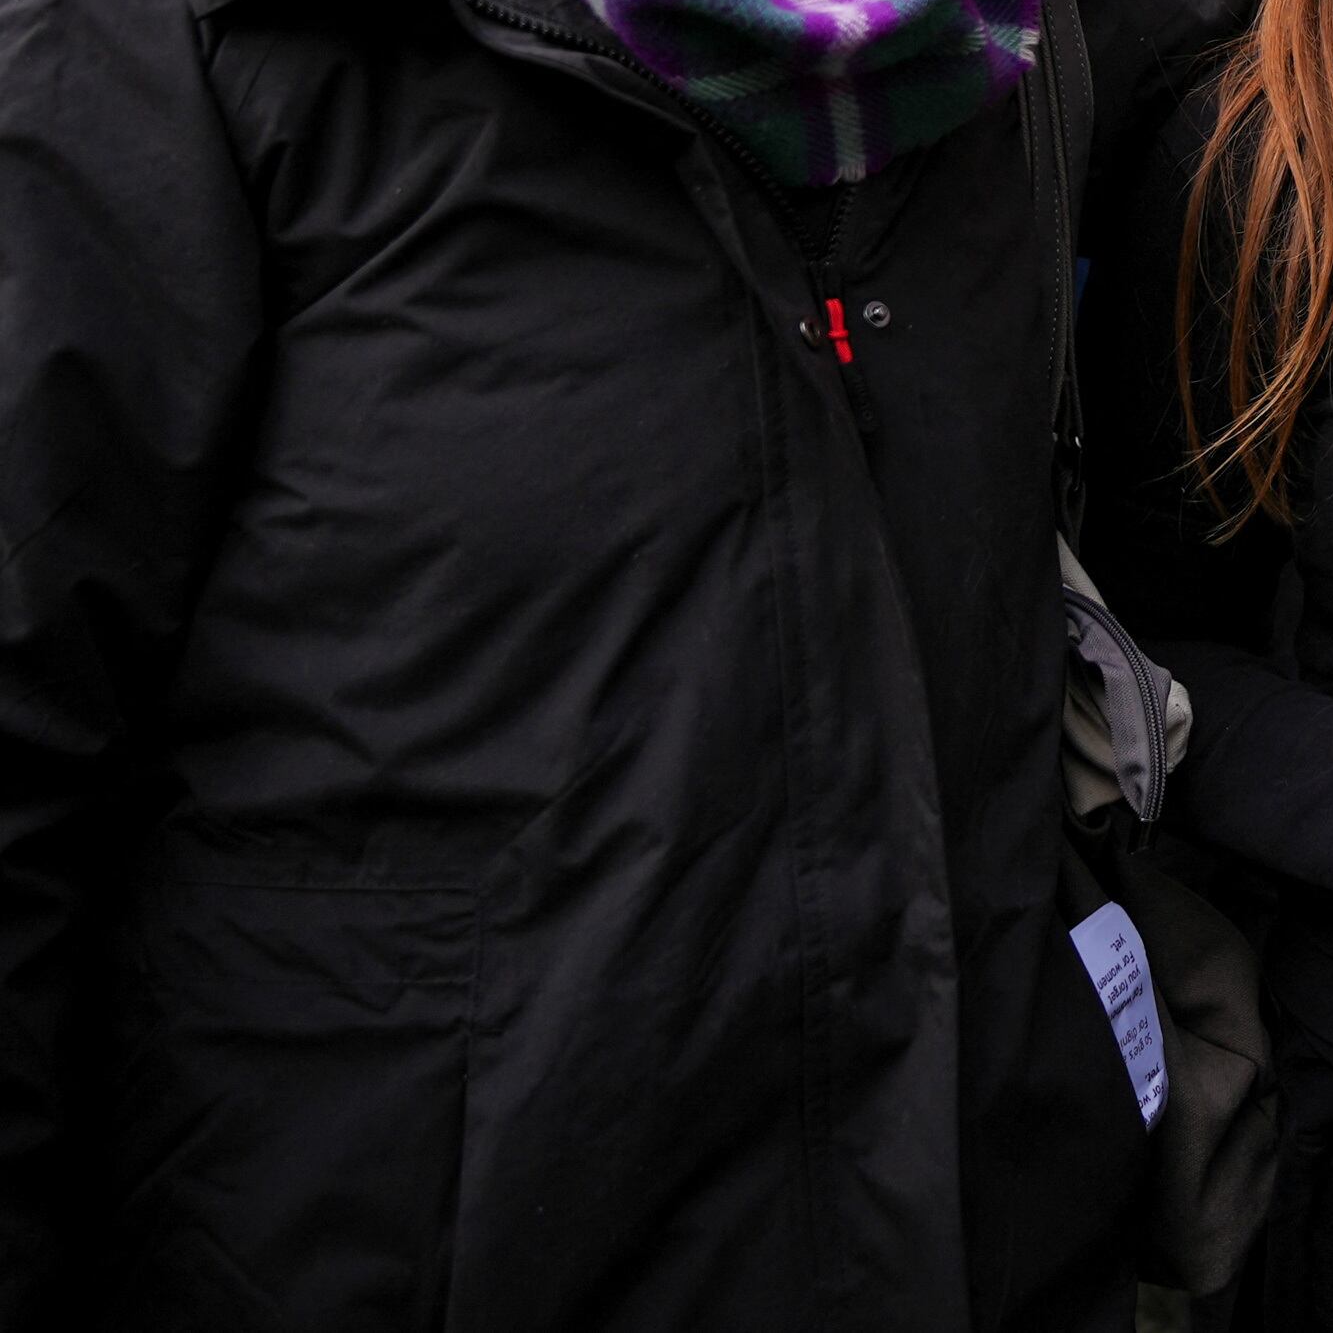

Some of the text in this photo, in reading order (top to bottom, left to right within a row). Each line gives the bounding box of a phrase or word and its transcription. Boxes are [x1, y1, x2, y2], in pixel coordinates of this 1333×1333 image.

[1110, 933, 1127, 953] yet.
[1122, 950, 1136, 967] For
[1107, 964, 1141, 1005] you forget
